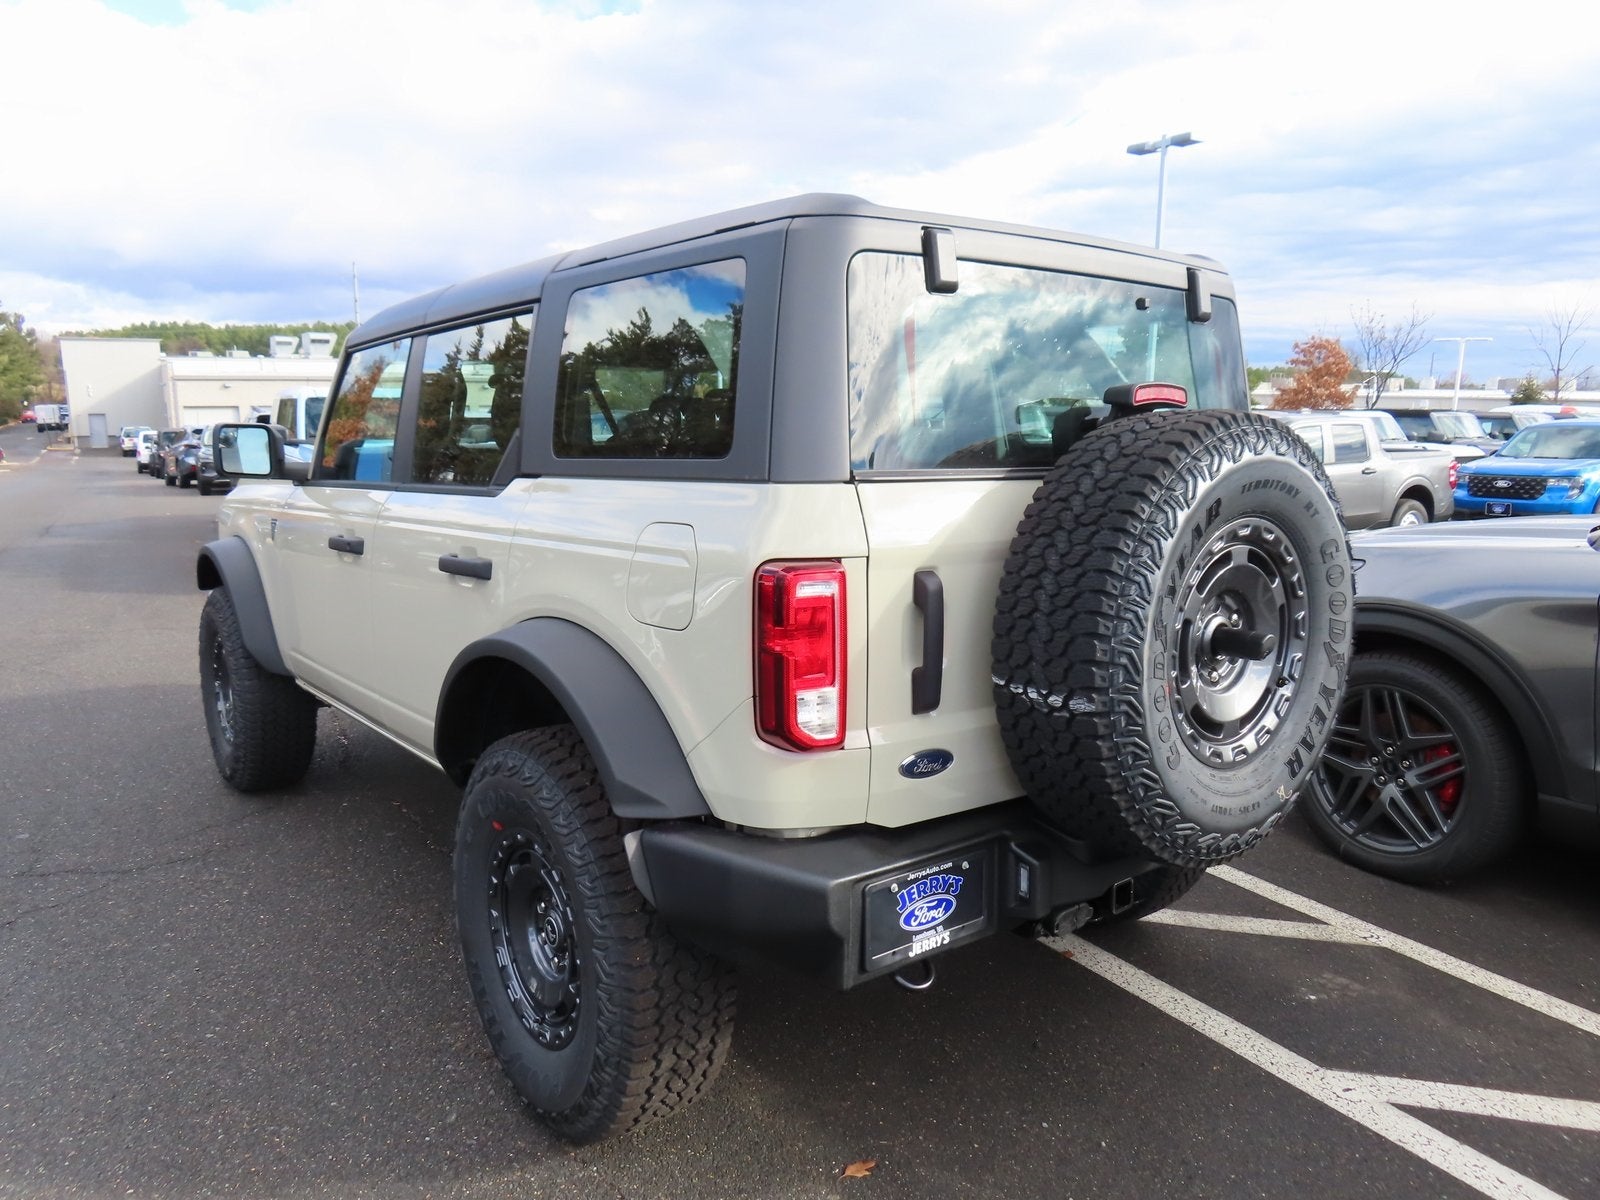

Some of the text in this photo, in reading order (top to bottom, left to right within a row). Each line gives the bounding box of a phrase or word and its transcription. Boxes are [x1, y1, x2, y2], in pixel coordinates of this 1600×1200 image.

[1240, 479, 1301, 499] TERRITORY
[907, 861, 953, 881] JerrysAuto.com
[896, 874, 964, 913] JERRY'S
[911, 900, 946, 927] Ford
[908, 931, 951, 958] JERRY'S
